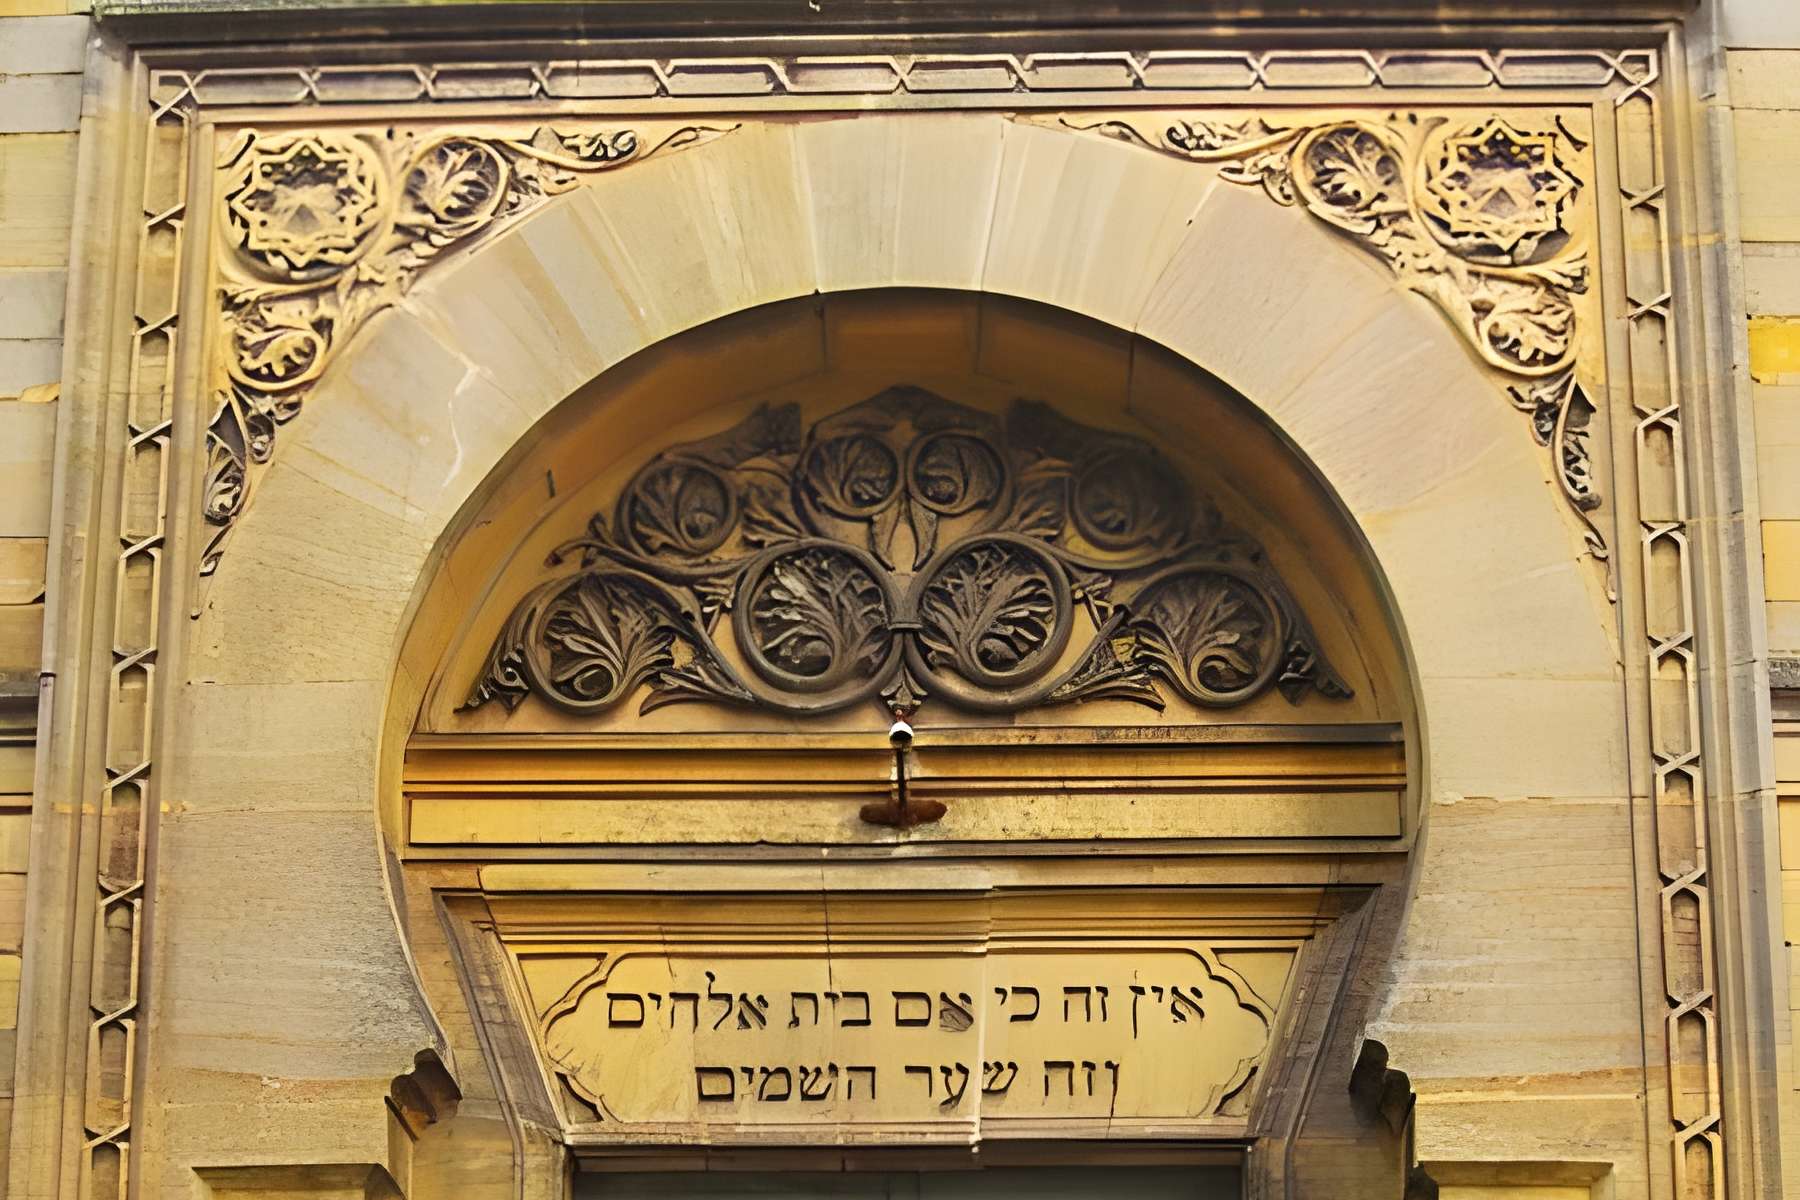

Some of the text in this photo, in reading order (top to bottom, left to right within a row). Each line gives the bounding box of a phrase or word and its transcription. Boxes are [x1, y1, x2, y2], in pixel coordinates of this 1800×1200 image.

[788, 991, 872, 1029] בית
[891, 991, 975, 1031] אם
[994, 986, 1041, 1022] כי
[1063, 986, 1109, 1022] זה
[1129, 985, 1205, 1039] אין
[694, 1062, 877, 1103] השמים
[904, 1061, 1018, 1112] שער
